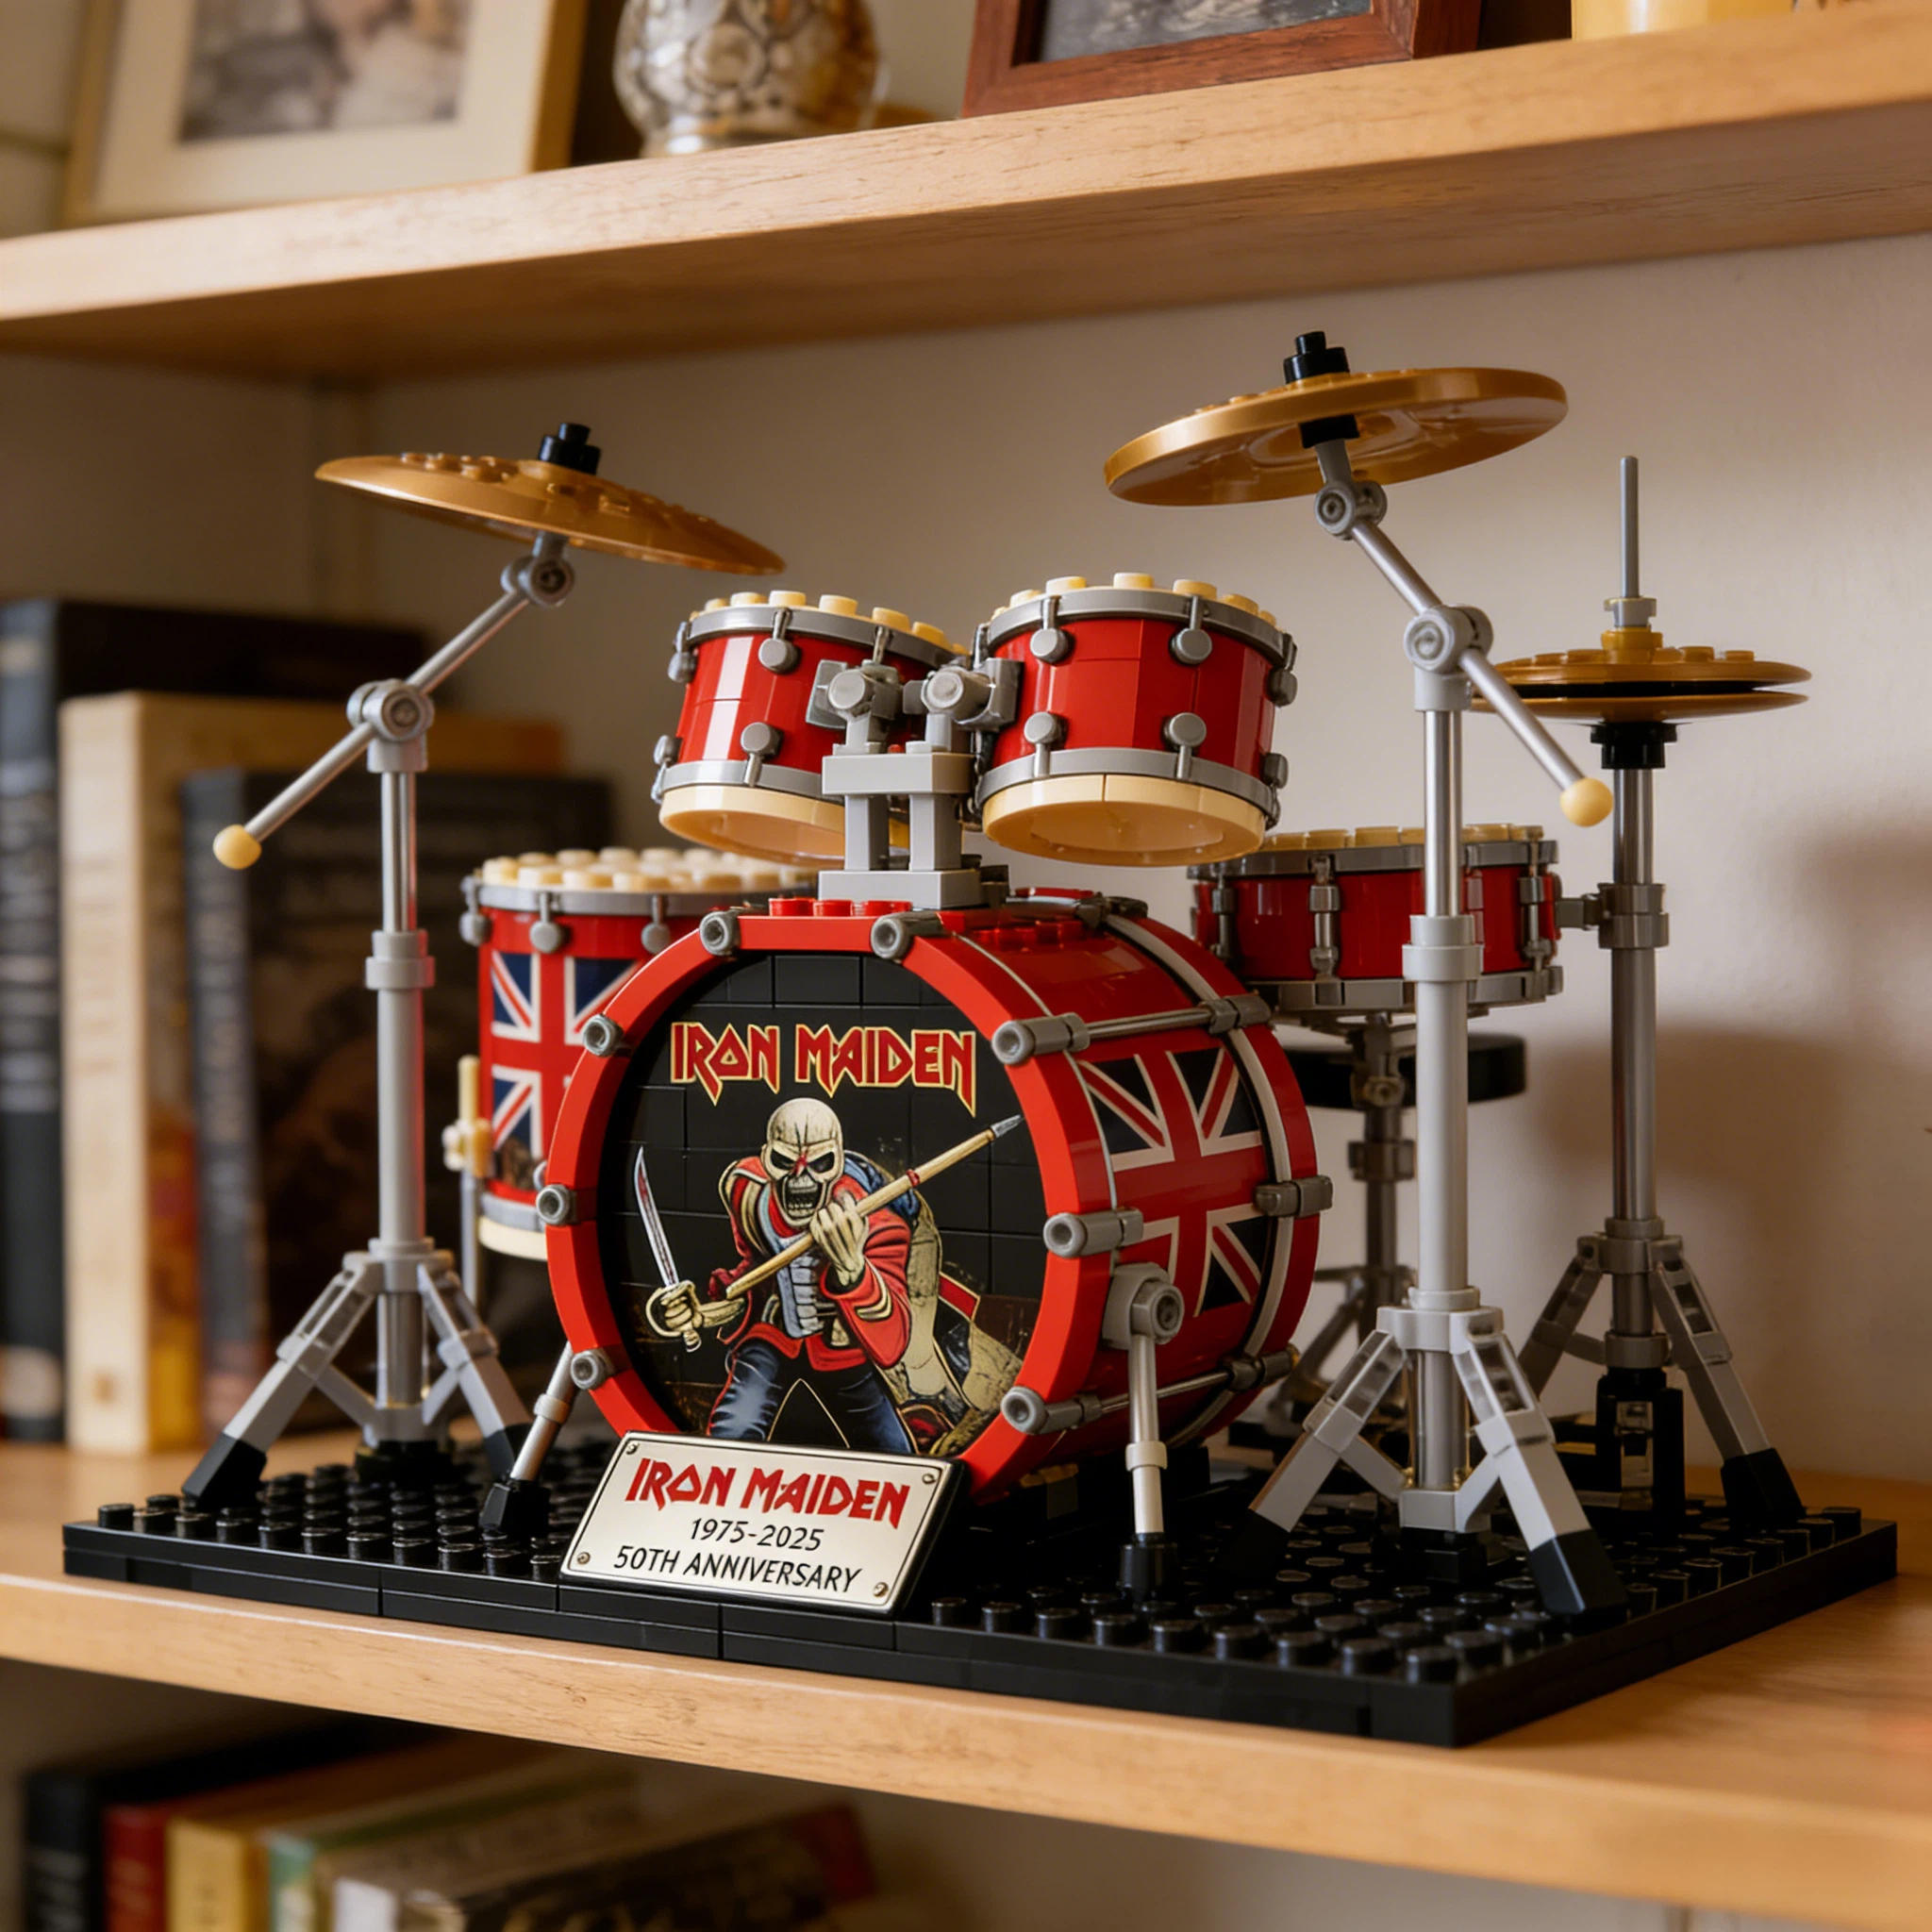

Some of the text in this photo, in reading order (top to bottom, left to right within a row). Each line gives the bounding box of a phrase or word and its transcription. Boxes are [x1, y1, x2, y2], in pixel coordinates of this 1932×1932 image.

[671, 1022, 976, 1118] IRON MAIDEN
[625, 1457, 910, 1529] IRON MAIDEN
[691, 1519, 824, 1551] 1975-2025
[614, 1545, 862, 1593] 50TH ANNIVERSARY
